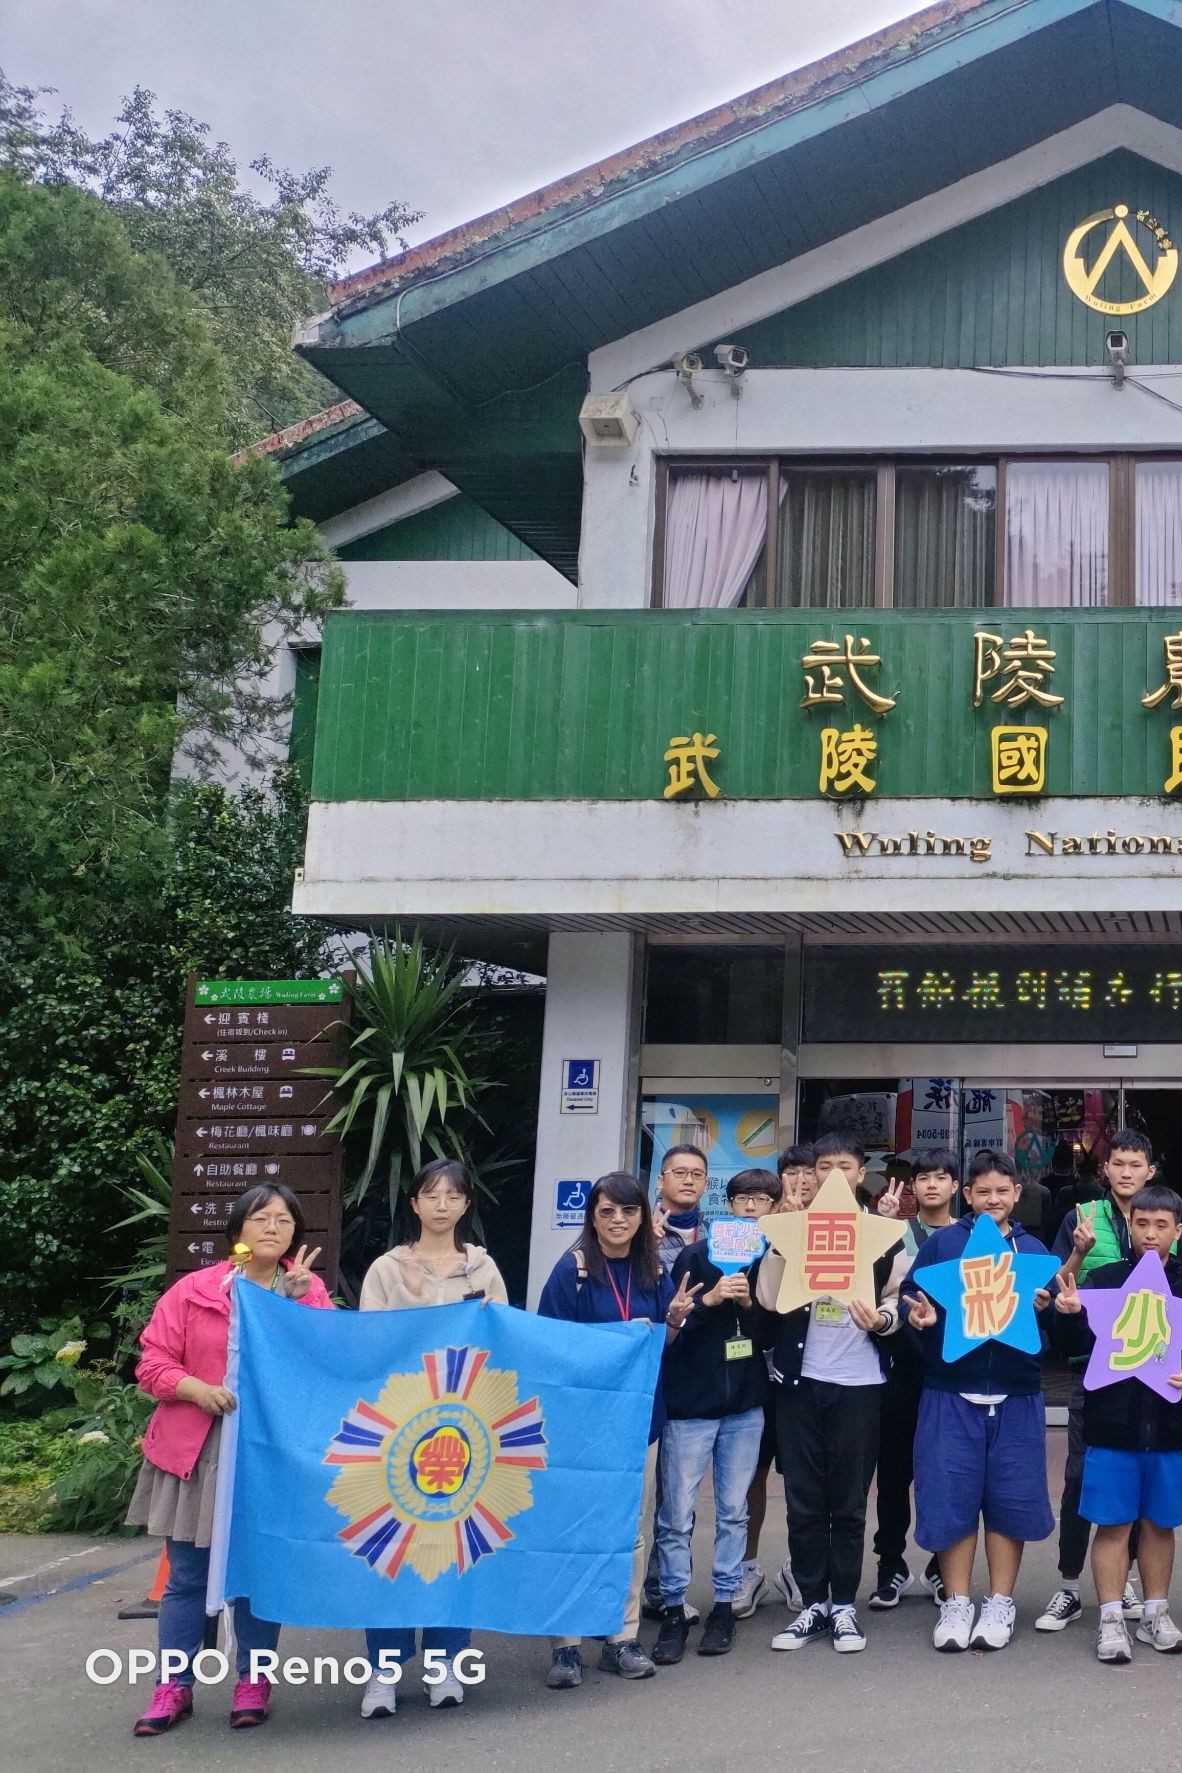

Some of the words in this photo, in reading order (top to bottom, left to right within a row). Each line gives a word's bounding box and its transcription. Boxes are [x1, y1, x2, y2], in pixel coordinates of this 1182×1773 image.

[834, 831, 993, 862] Wuling
[237, 1065, 270, 1074] Building
[213, 1086, 265, 1100] 楓林木屋
[211, 1103, 236, 1112] Maple
[236, 1103, 267, 1112] Cottage
[208, 1142, 250, 1150] Restaurant
[206, 1163, 258, 1176] 自助餐廳
[206, 1180, 247, 1188] Restaurant
[804, 1211, 857, 1292] 雲
[962, 1253, 1016, 1336] 彩
[1109, 1292, 1169, 1370] 少
